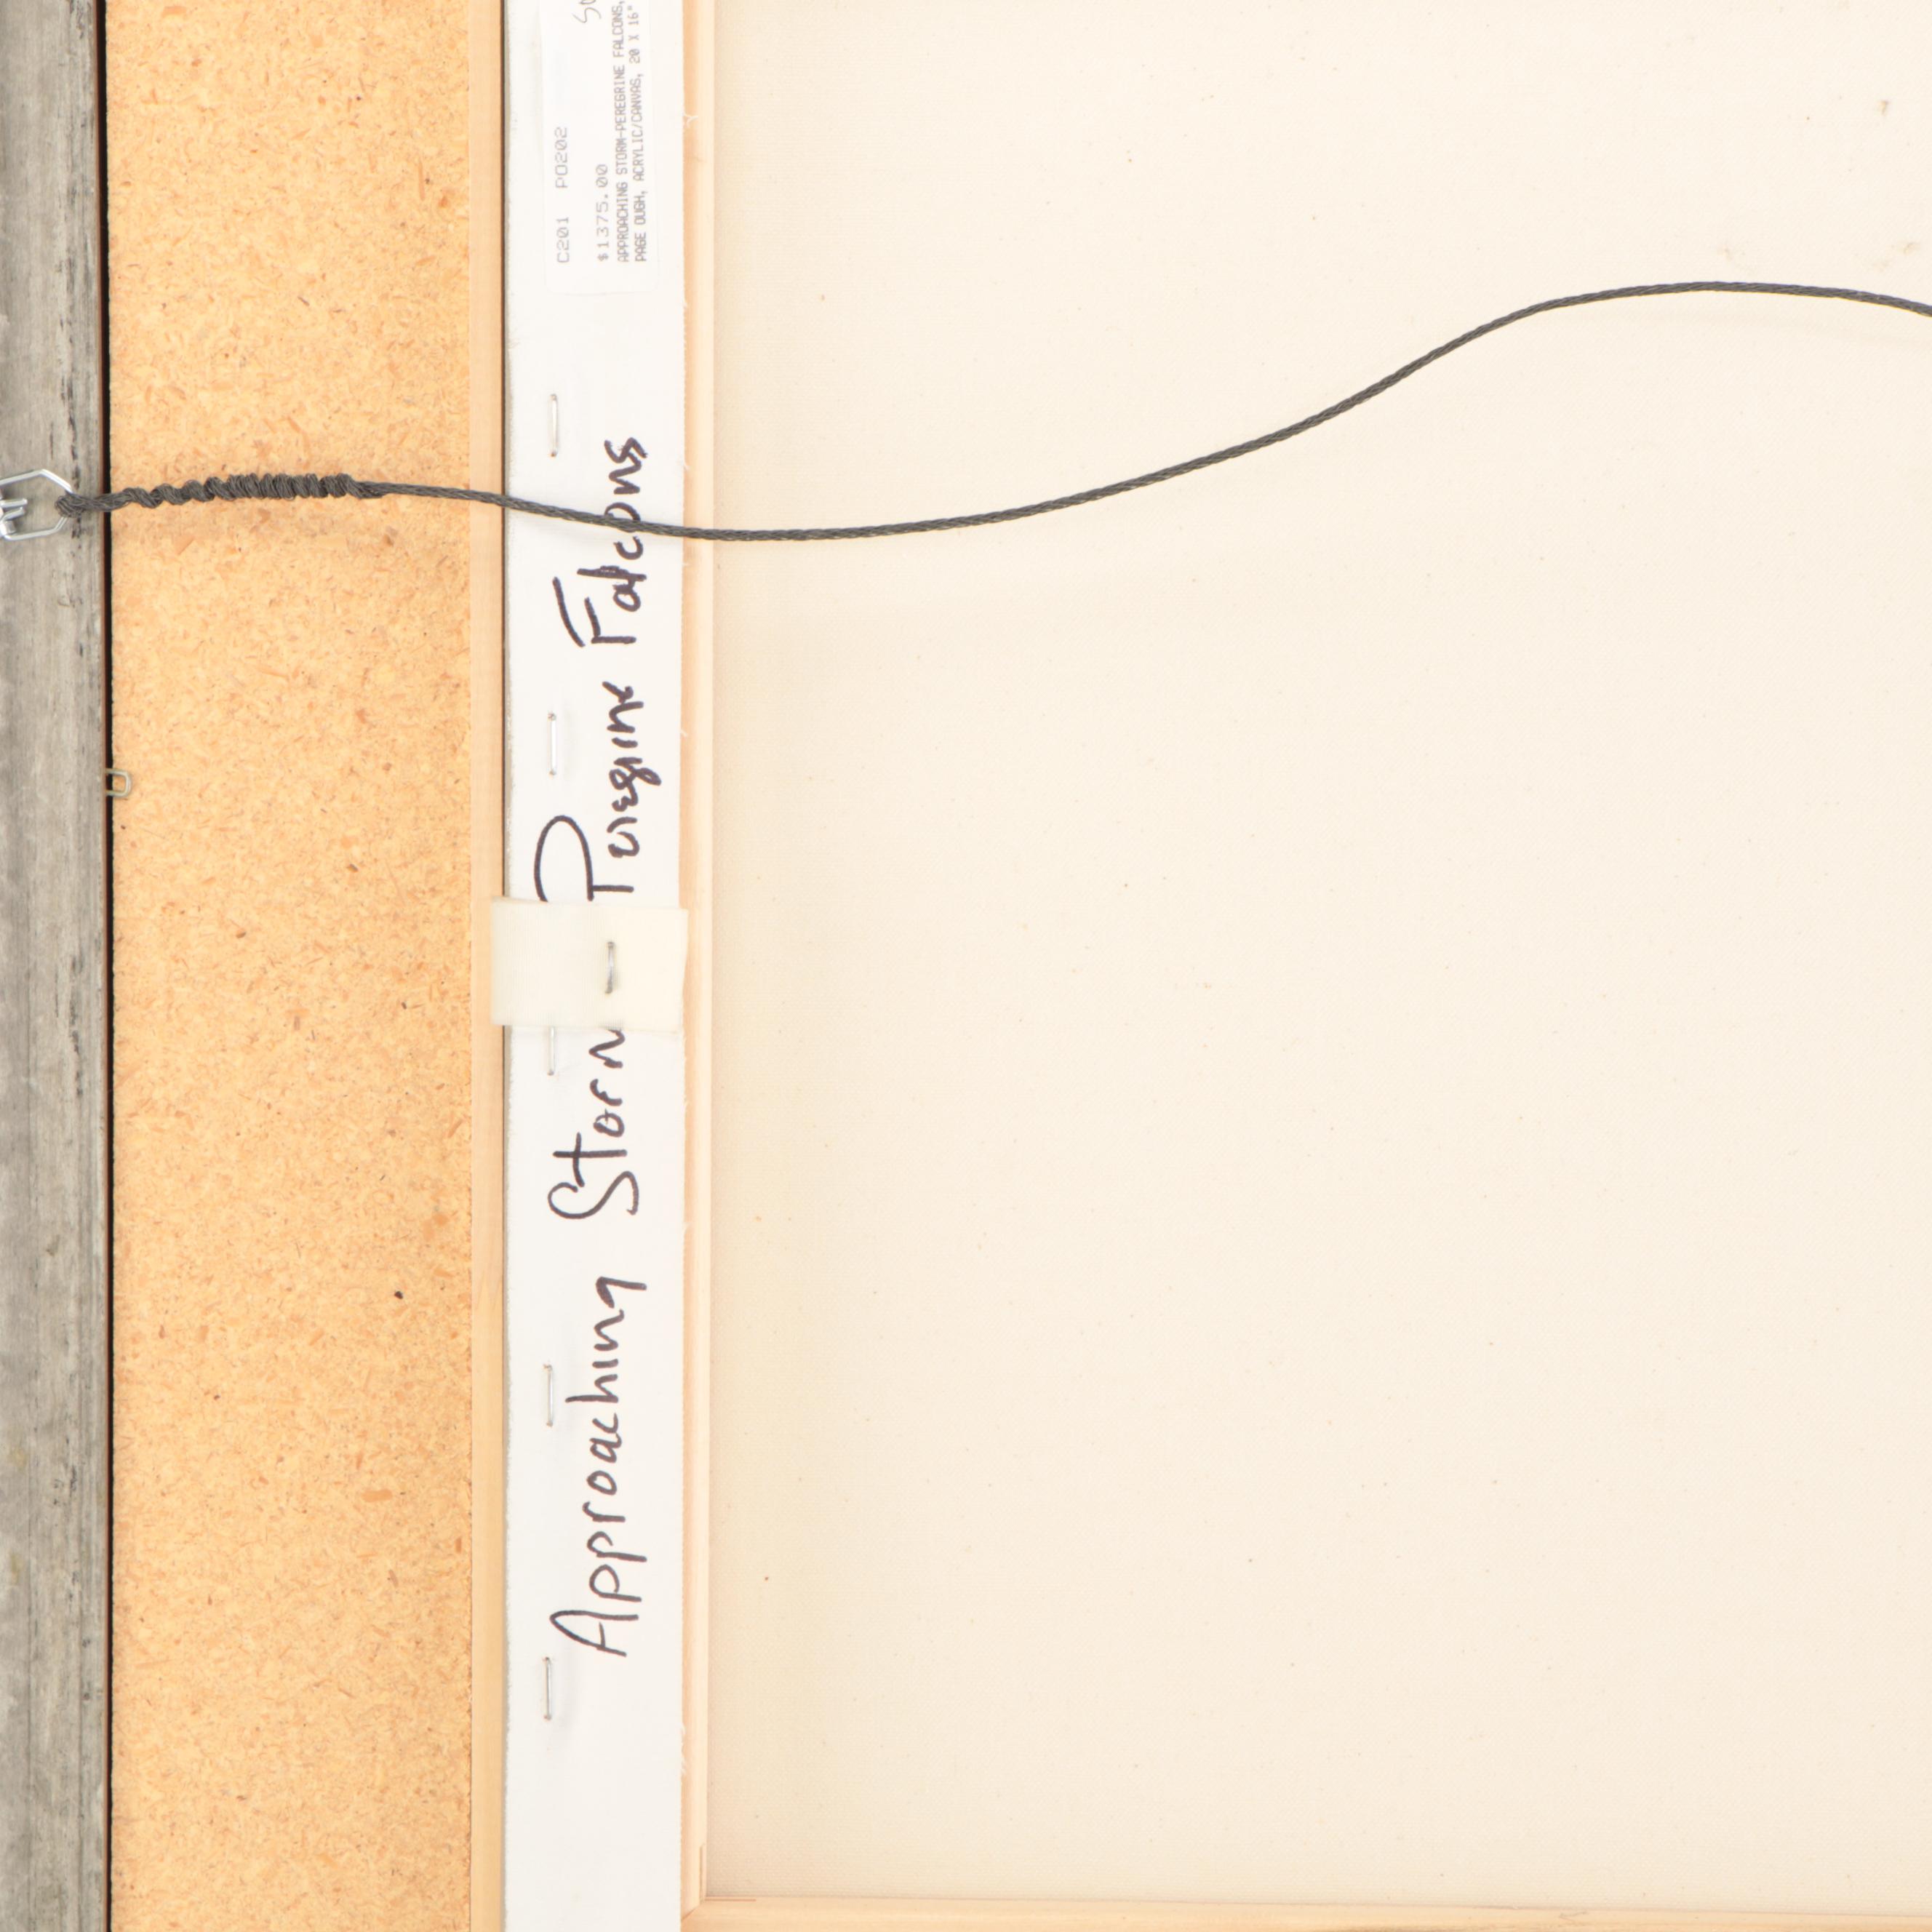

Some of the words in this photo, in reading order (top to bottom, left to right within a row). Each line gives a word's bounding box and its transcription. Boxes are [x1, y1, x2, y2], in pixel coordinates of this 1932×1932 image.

[611, 1, 625, 58] FALCONS,
[628, 48, 641, 65] 20
[612, 64, 628, 176] STORM-PEREGRINE
[629, 73, 645, 182] ACRYLIC/CANVAS,
[556, 216, 570, 264] C201
[595, 164, 609, 263] $1375.00
[615, 181, 630, 263] APPROACHING
[632, 191, 648, 226] OUGH,
[634, 232, 647, 263] PAGE
[551, 436, 649, 648] Falcons
[549, 1276, 647, 1658] Approaching
